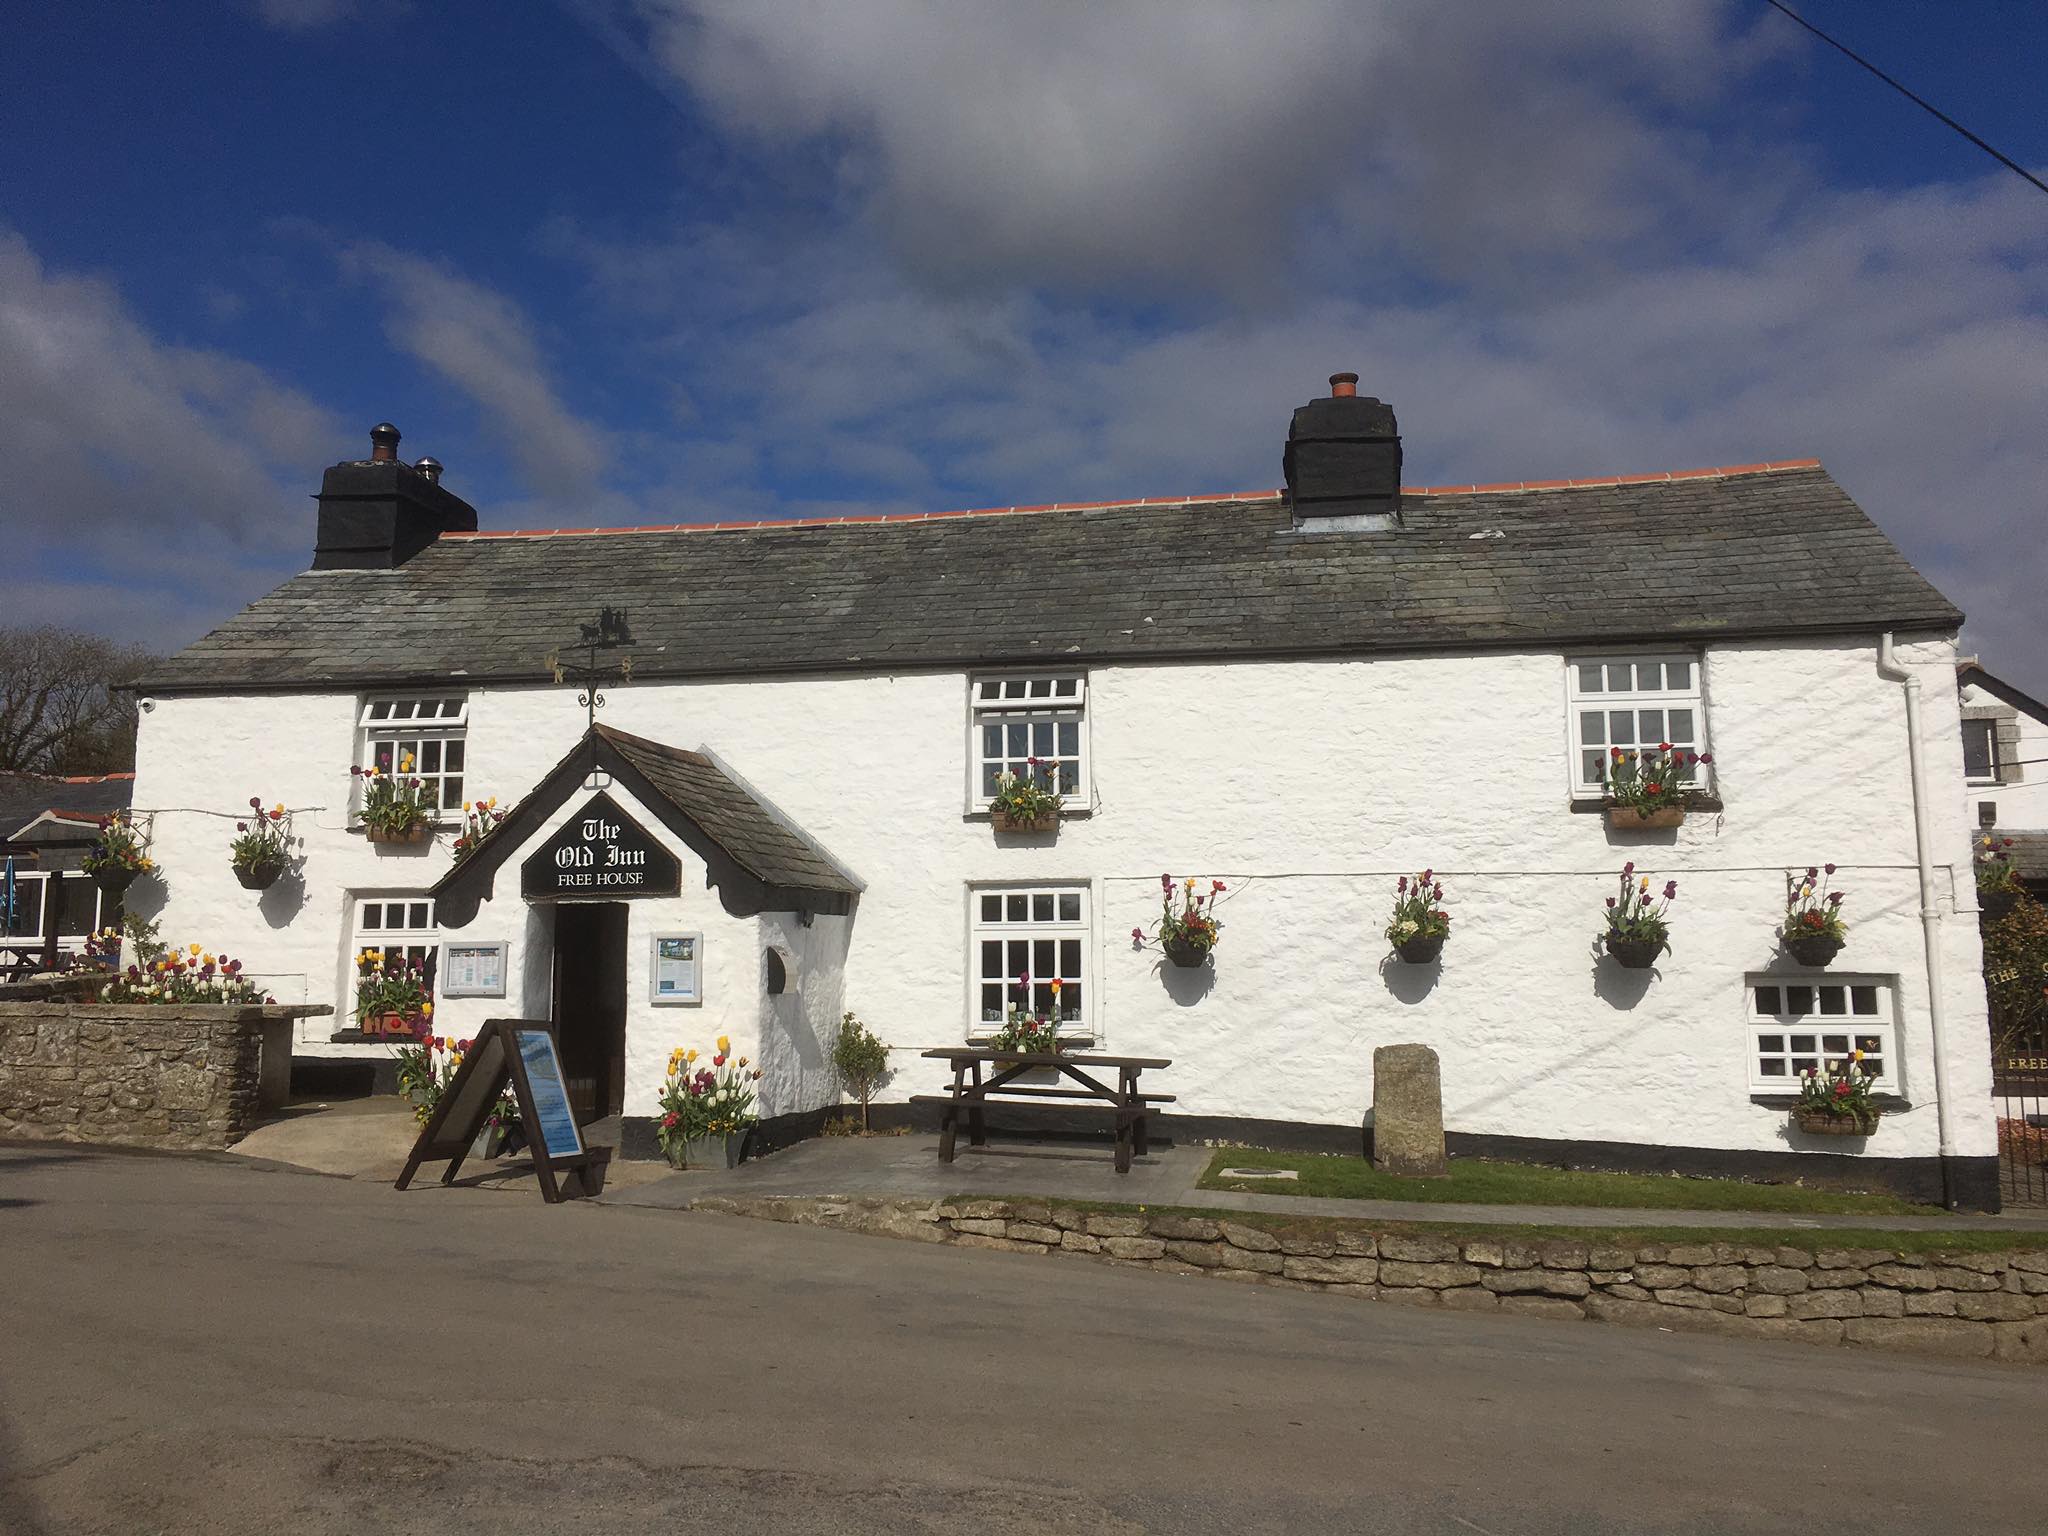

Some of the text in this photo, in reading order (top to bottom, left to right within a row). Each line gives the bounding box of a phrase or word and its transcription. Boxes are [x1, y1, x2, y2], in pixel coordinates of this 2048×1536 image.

[582, 819, 621, 842] The
[555, 844, 646, 869] Old Inn
[557, 872, 644, 887] FREE HOUSE
[1989, 967, 2020, 985] THE
[2008, 1058, 2048, 1070] FREE
